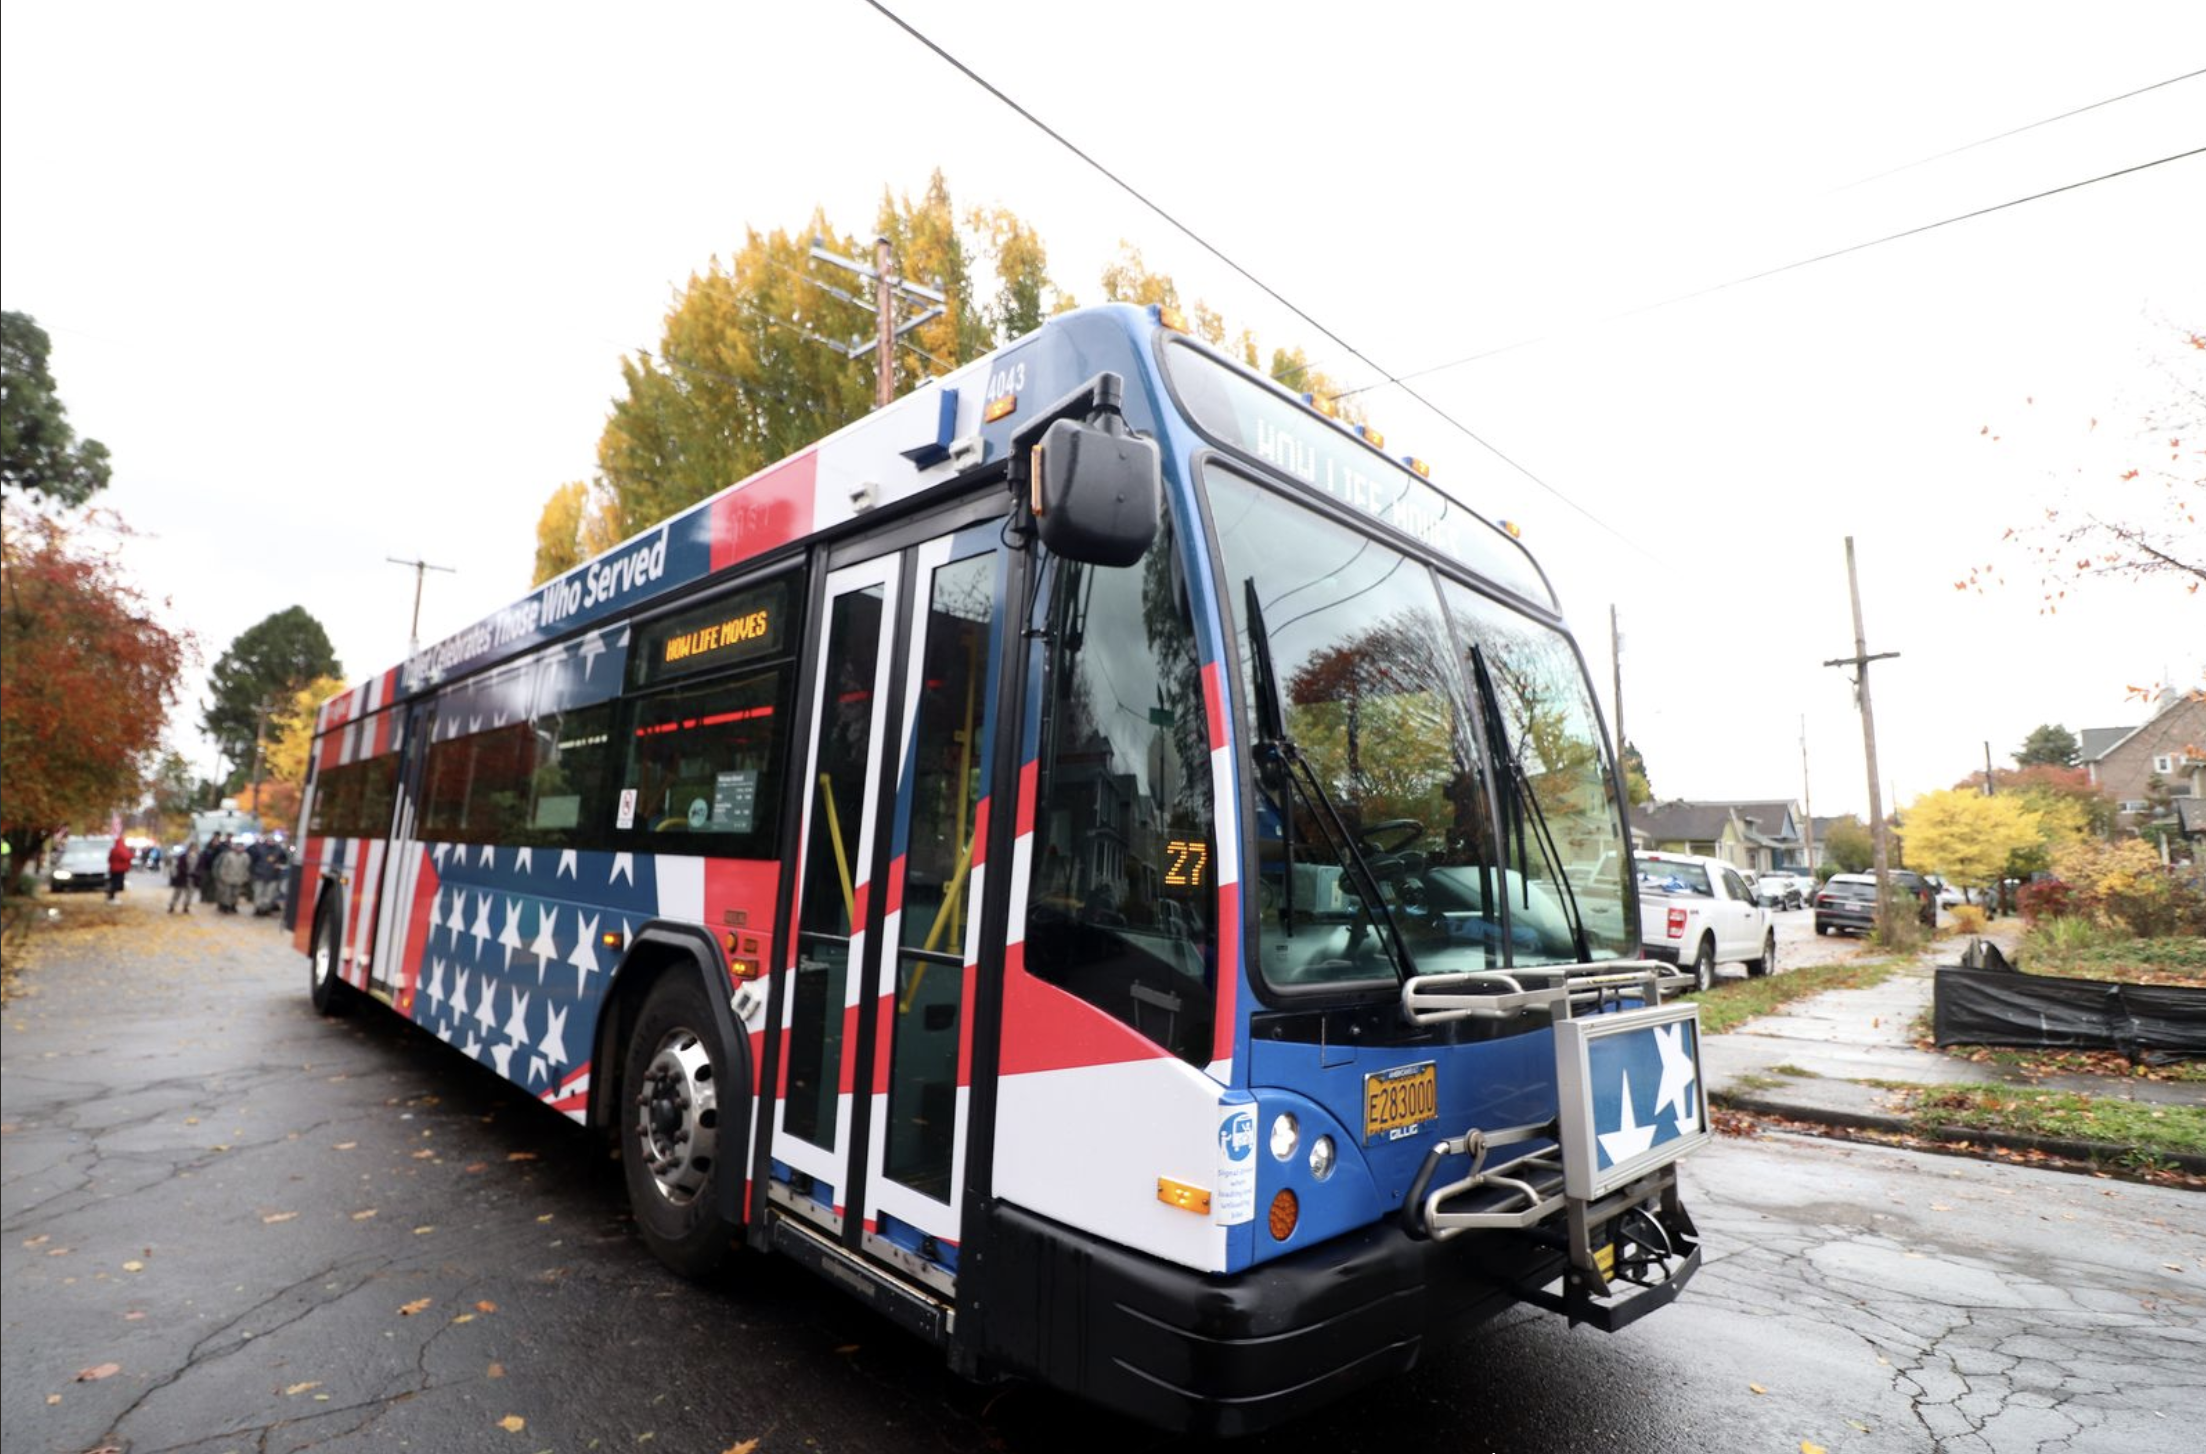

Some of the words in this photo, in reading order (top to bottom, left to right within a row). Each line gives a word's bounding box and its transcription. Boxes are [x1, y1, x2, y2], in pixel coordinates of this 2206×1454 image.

[987, 362, 1025, 402] 4043
[434, 627, 491, 669] Celebrates
[494, 602, 538, 647] Those
[541, 578, 581, 627] Who
[583, 524, 670, 609] Served
[666, 638, 691, 662] HOW
[692, 625, 720, 655] LIFE
[721, 610, 768, 647] MOVES
[1165, 841, 1207, 886] 27
[1369, 1079, 1434, 1124] E283000
